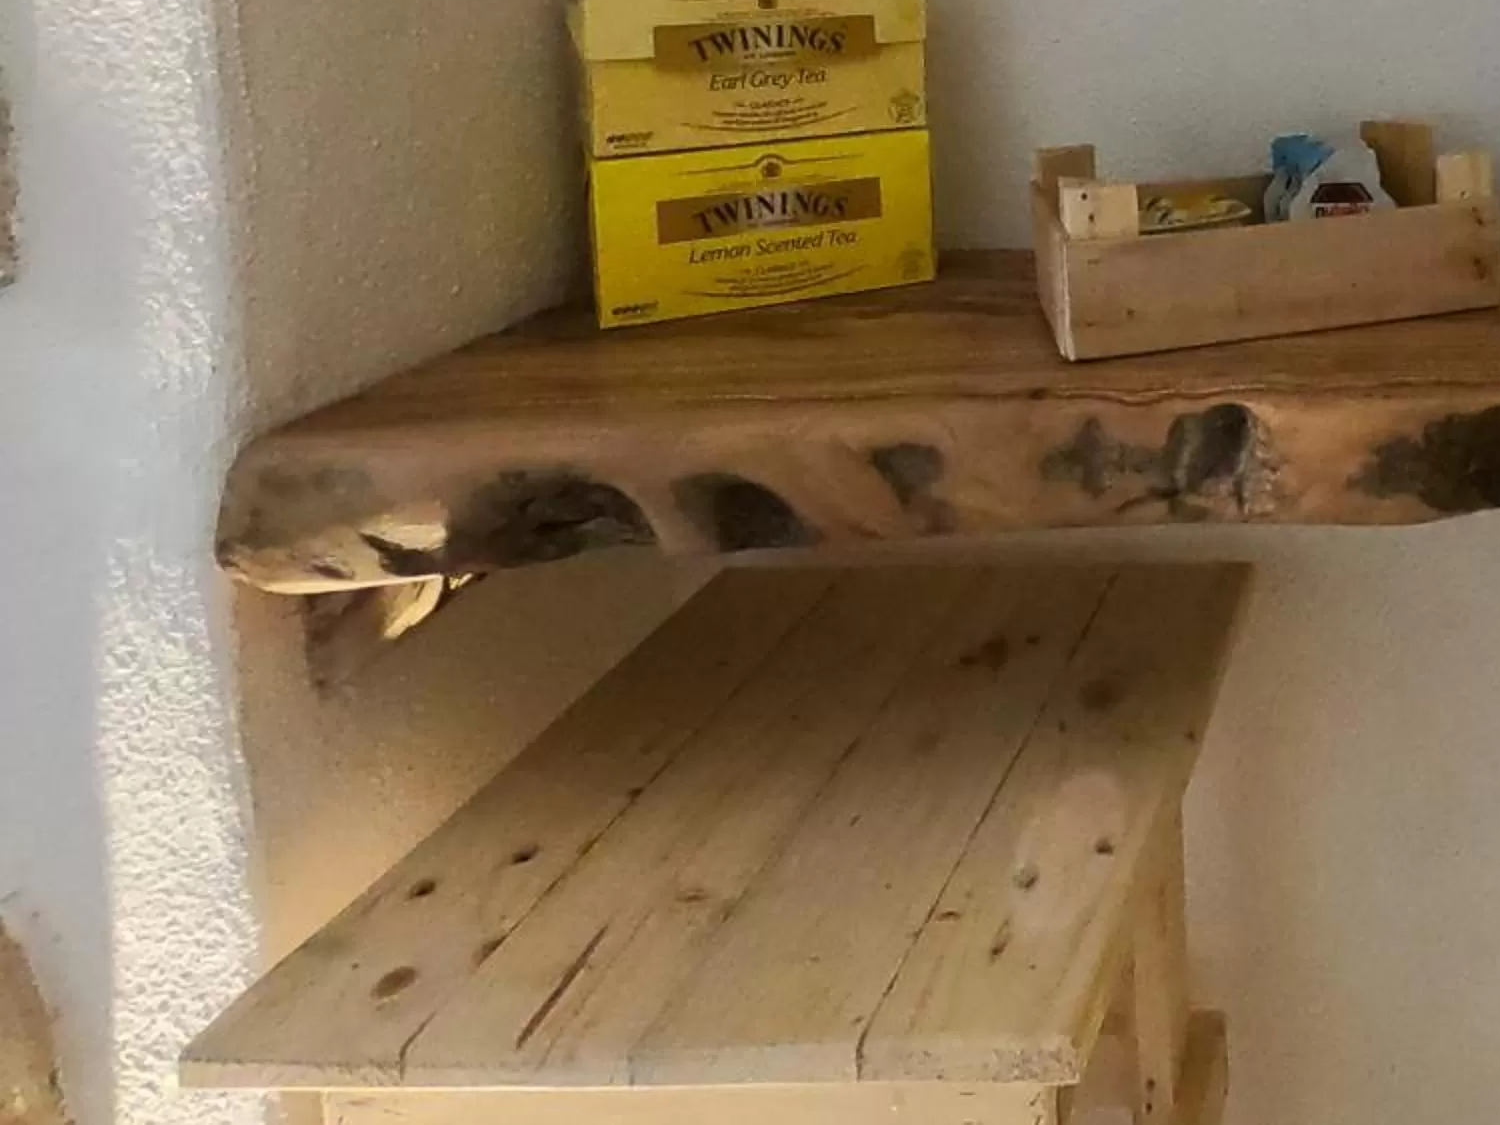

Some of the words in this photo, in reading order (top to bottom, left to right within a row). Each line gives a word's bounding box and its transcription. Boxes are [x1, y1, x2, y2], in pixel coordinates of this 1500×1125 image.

[688, 23, 847, 62] TWININGS
[709, 73, 747, 92] Earl
[750, 70, 794, 91] Grey
[797, 67, 828, 86] Tea
[691, 188, 850, 234] TWININGS
[688, 242, 751, 264] Lemon
[755, 233, 824, 256] Scented
[826, 228, 858, 246] Tea
